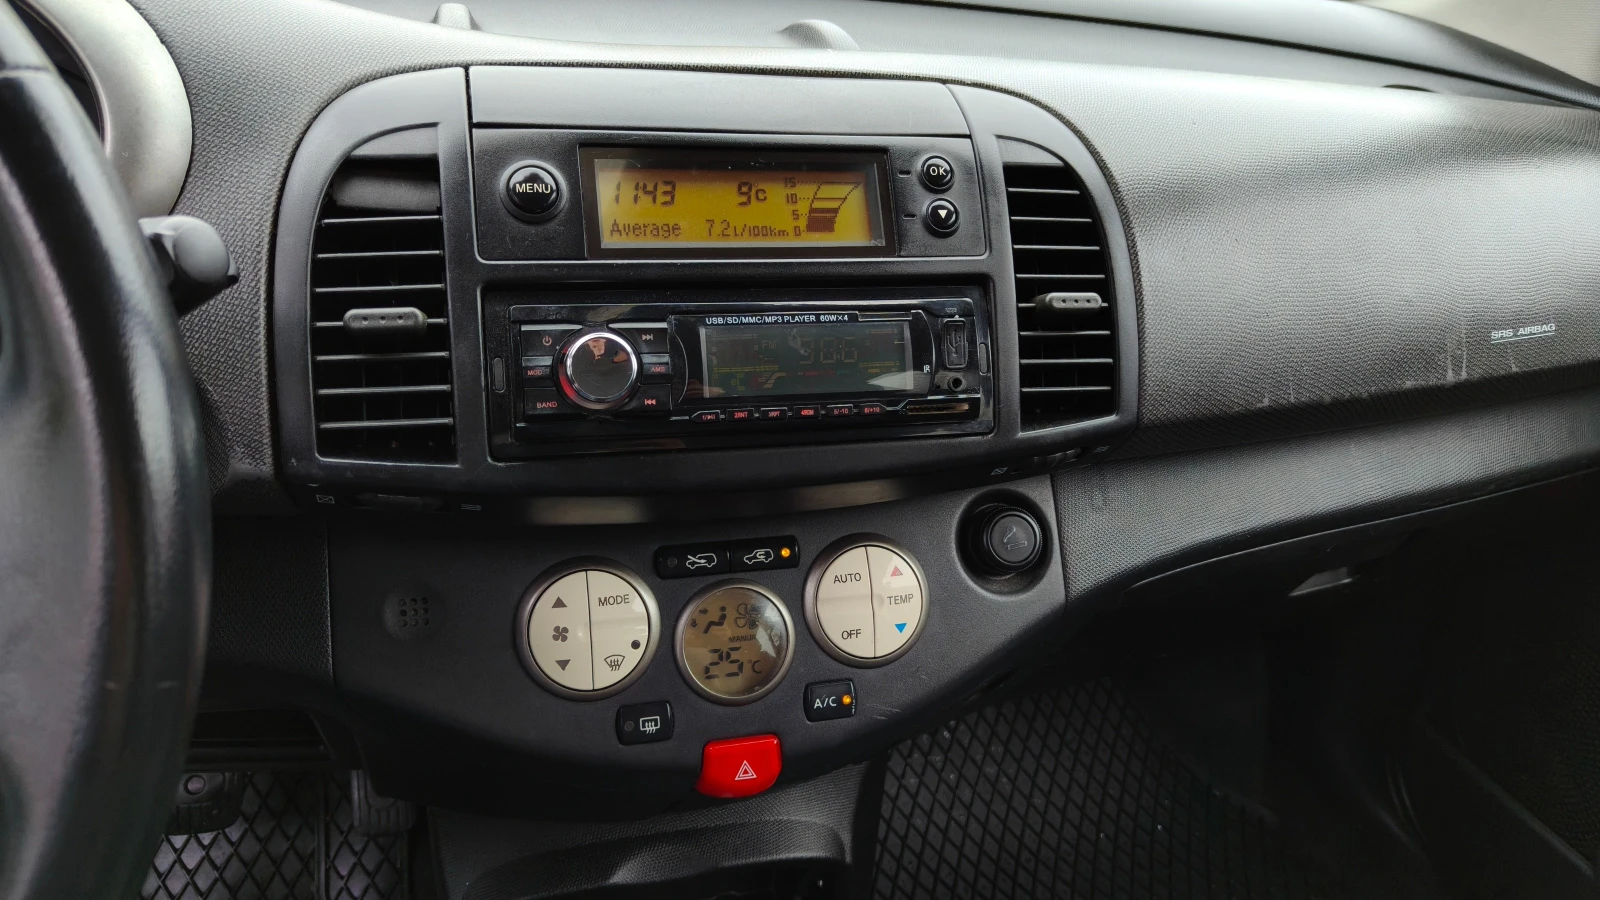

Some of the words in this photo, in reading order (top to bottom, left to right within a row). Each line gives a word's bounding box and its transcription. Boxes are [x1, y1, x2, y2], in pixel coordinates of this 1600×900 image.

[929, 166, 947, 176] OK
[784, 177, 796, 188] 15
[515, 183, 551, 194] MENU
[785, 193, 798, 205] 10
[792, 210, 800, 220] 5
[609, 219, 682, 239] Average
[794, 225, 802, 237] 0
[706, 316, 783, 325] USB/SD/MMC/MP3
[784, 315, 816, 323] PLAYER
[1491, 329, 1513, 339] SRS
[1518, 323, 1556, 336] AIRBAG
[536, 401, 558, 409] BAND
[833, 573, 862, 584] AUTO
[598, 594, 630, 607] MODE
[887, 593, 915, 606] TEMP
[841, 629, 862, 640] OFF
[814, 696, 837, 709] A/C
